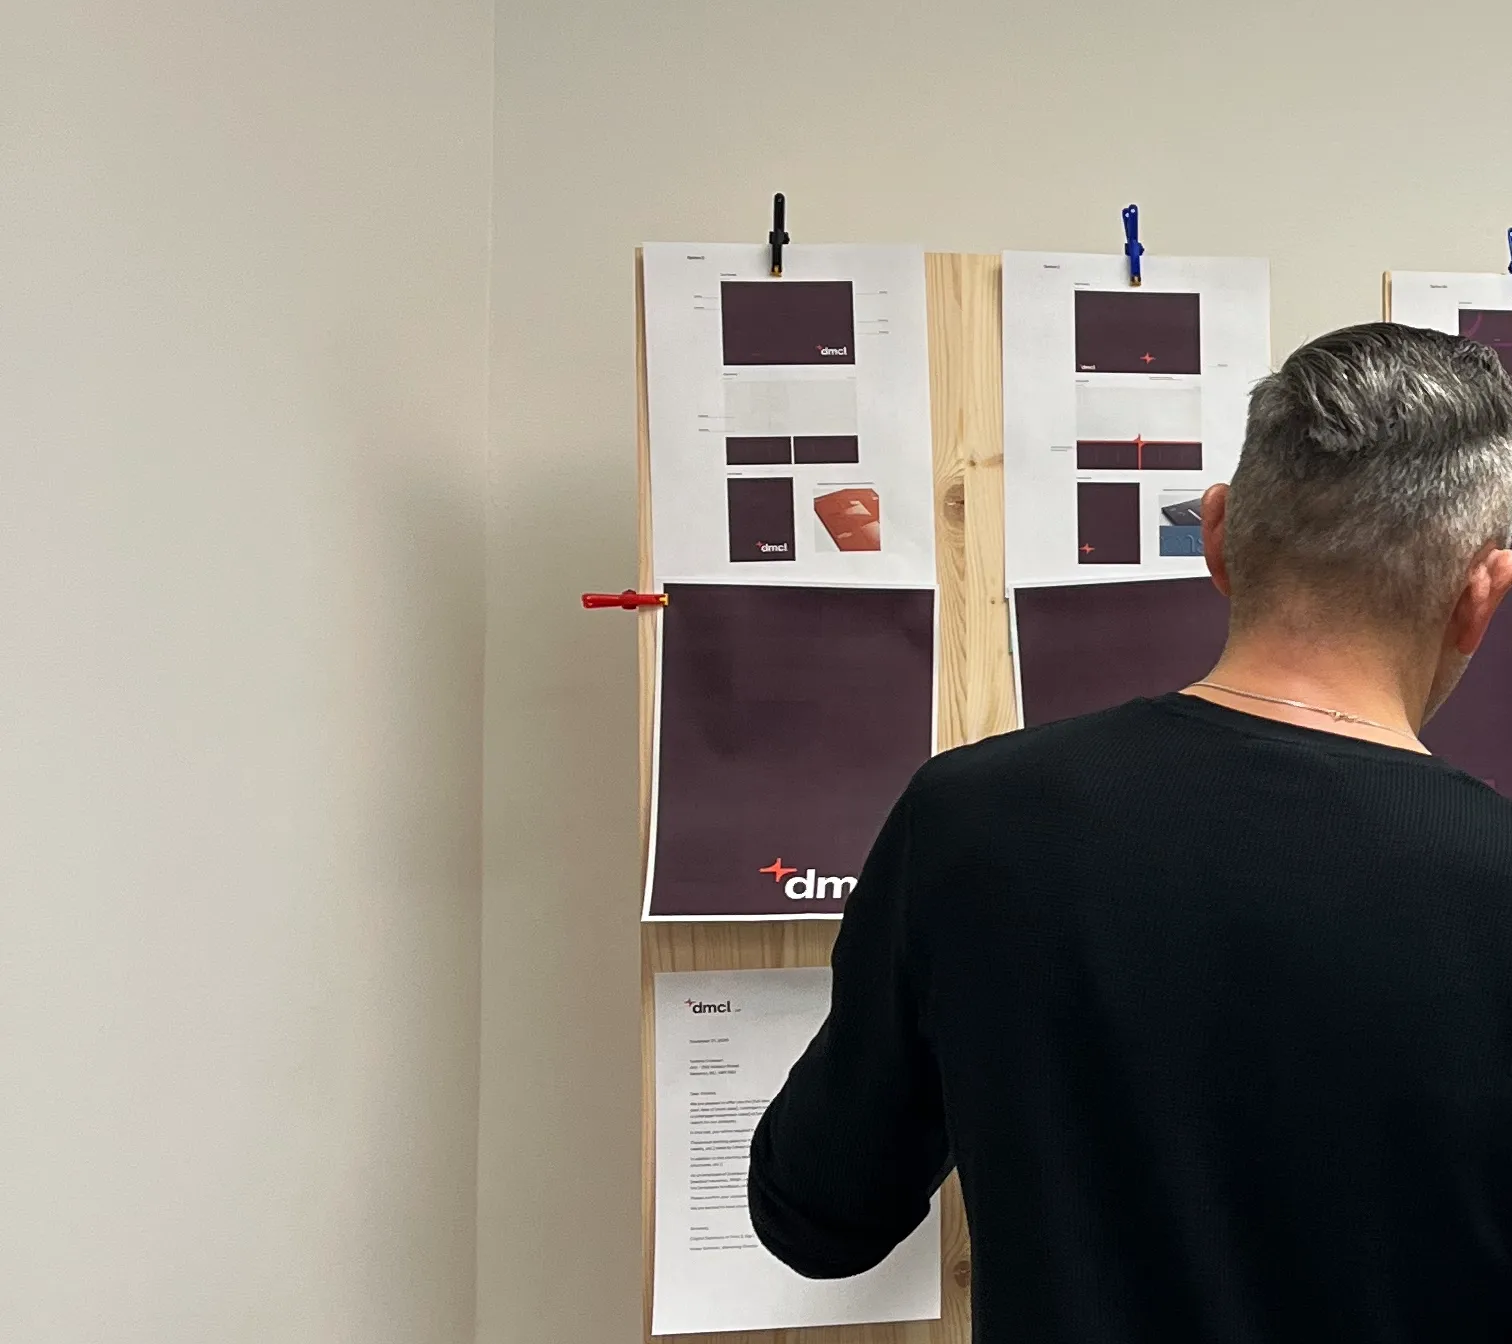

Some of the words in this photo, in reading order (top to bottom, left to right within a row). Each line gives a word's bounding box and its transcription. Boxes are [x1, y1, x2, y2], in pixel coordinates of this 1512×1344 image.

[821, 346, 848, 356] dmcl
[761, 542, 788, 553] dmcl
[785, 869, 858, 900] dm
[692, 1000, 731, 1014] dmcl
